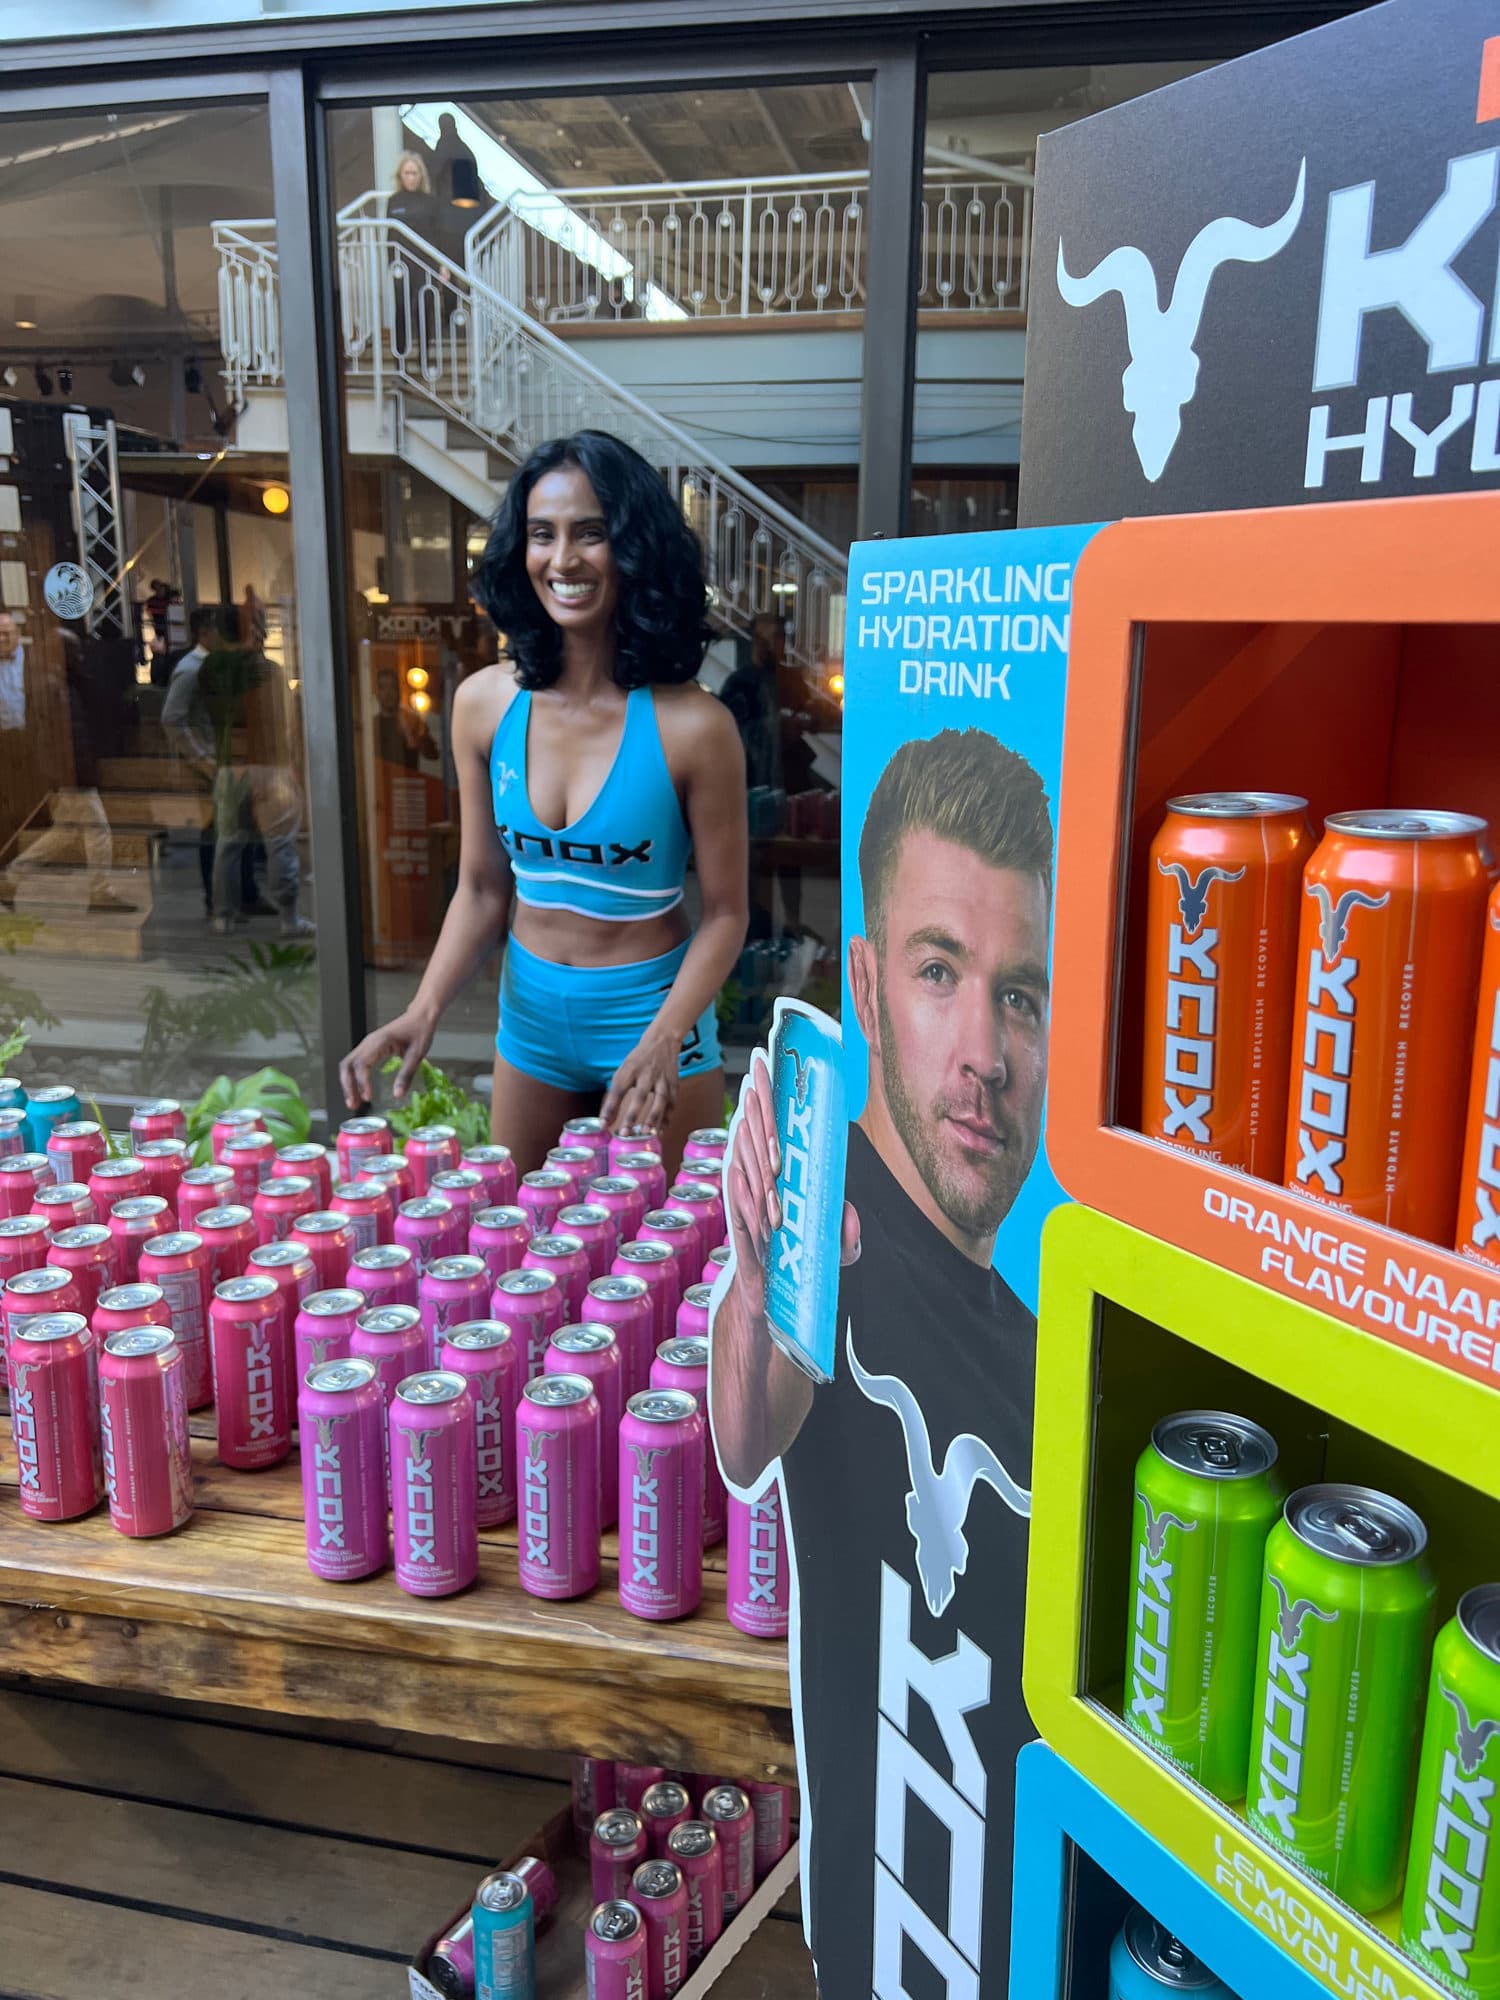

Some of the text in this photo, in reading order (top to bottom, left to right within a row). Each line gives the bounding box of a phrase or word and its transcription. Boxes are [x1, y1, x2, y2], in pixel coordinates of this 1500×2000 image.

[1311, 147, 1500, 393] K
[858, 613, 1069, 654] HYDRATION
[861, 562, 1070, 606] SPARKLING
[899, 660, 1010, 701] DRINK
[1162, 922, 1219, 1145] KNOX
[1257, 927, 1269, 988] RECOVER
[1295, 949, 1359, 1196] KNOX
[1385, 962, 1414, 1192] HYDRATE REPLENISH RECOVER
[1204, 1187, 1367, 1276] ORANGE
[1261, 1246, 1500, 1374] FLAVOURE
[1130, 1543, 1174, 1737] KNOX
[1257, 1629, 1310, 1842] KNOX
[1215, 1834, 1338, 1953] LEMON
[1420, 1748, 1495, 1980] KNOX
